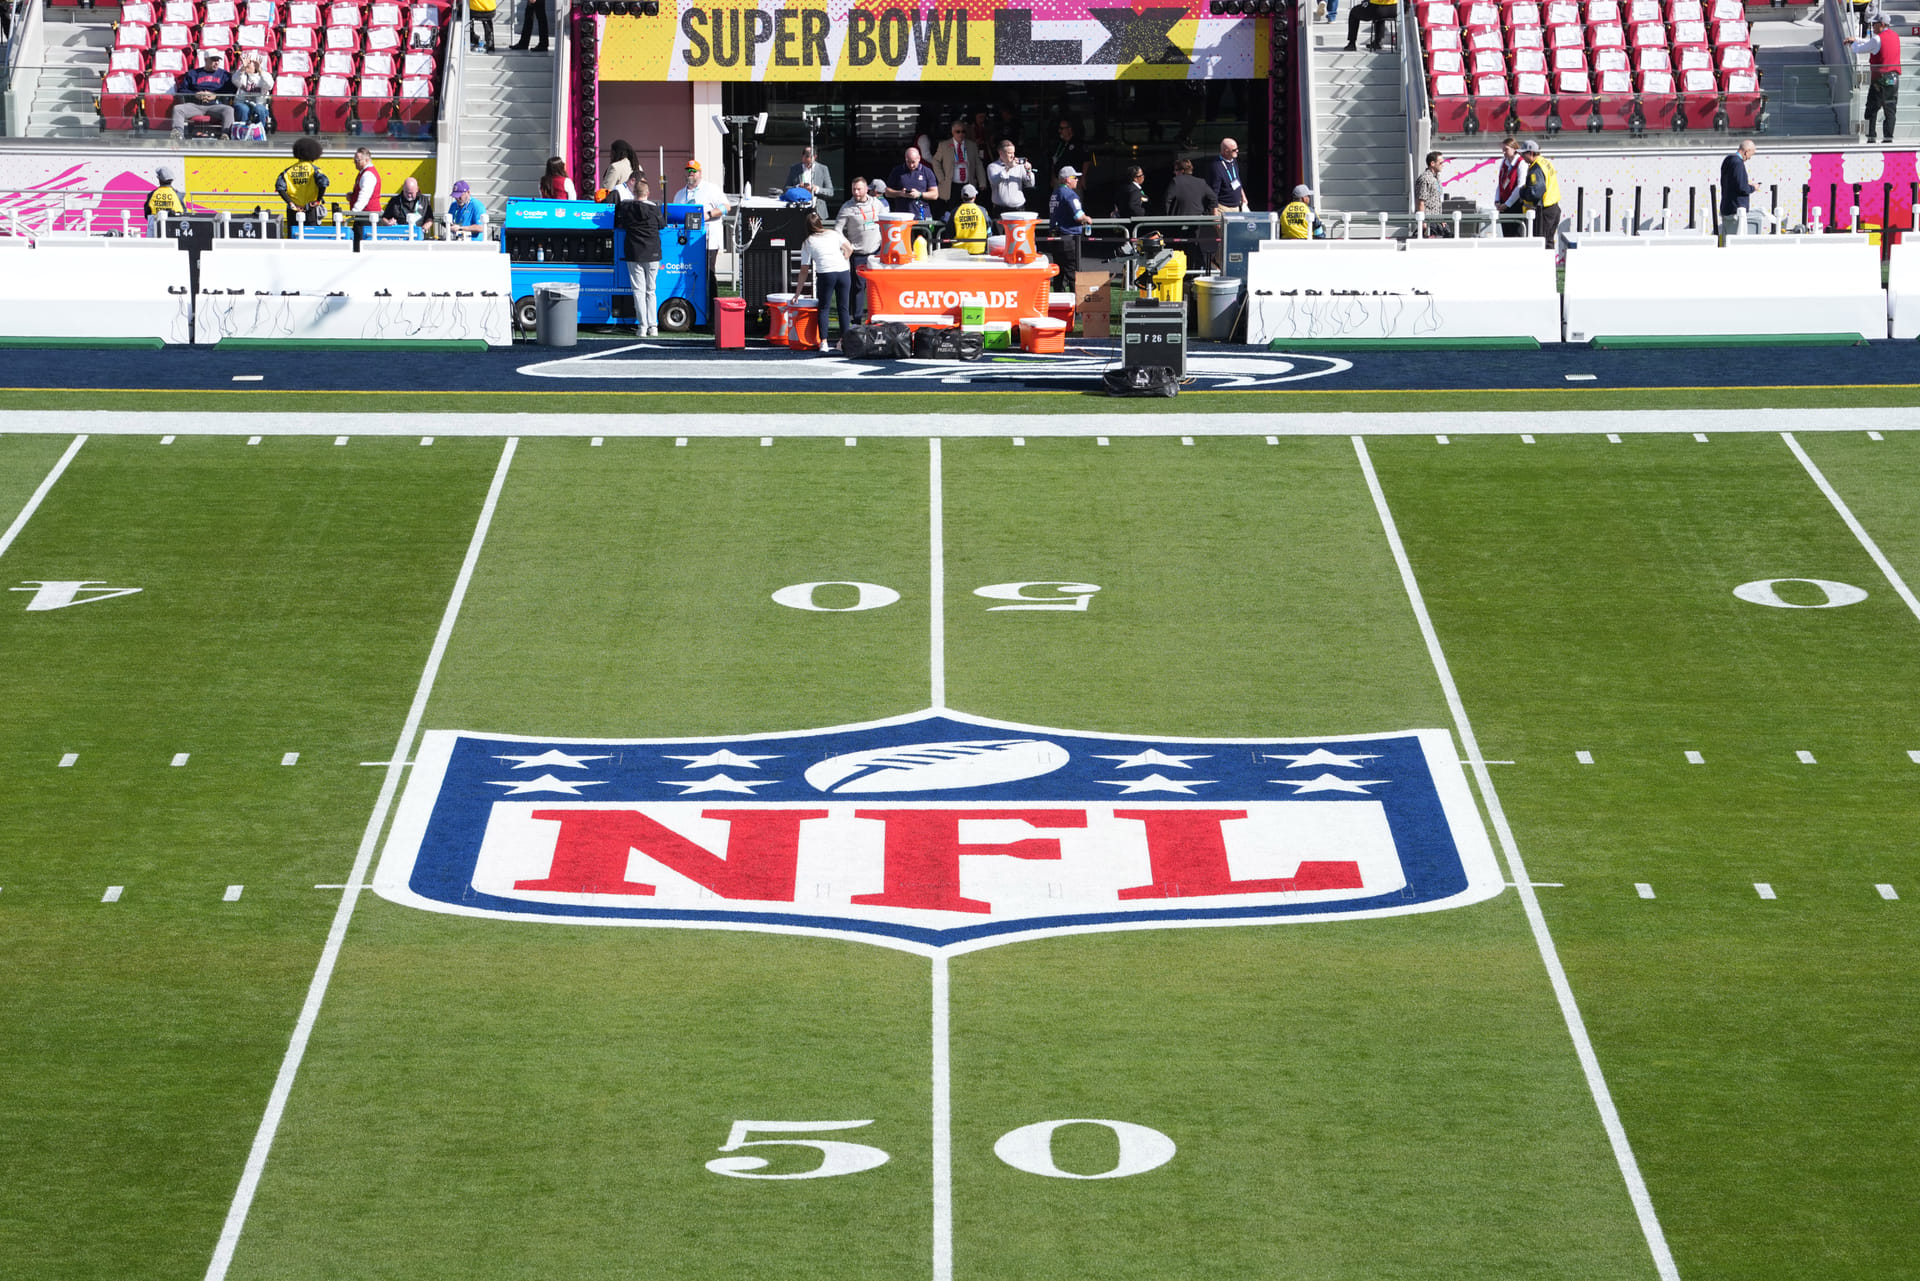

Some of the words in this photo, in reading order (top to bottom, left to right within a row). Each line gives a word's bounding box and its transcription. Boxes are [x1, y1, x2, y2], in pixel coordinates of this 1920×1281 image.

[681, 8, 831, 67] SUPER
[848, 8, 981, 67] BOWL
[994, 7, 1193, 65] LX
[959, 215, 979, 223] SECURITY
[182, 229, 193, 237] 44
[245, 230, 256, 238] 44
[888, 227, 901, 242] G
[1012, 226, 1026, 242] G
[666, 262, 692, 270] Copilot
[1144, 334, 1149, 343] F
[1152, 334, 1162, 343] 26
[513, 808, 1365, 914] NFL
